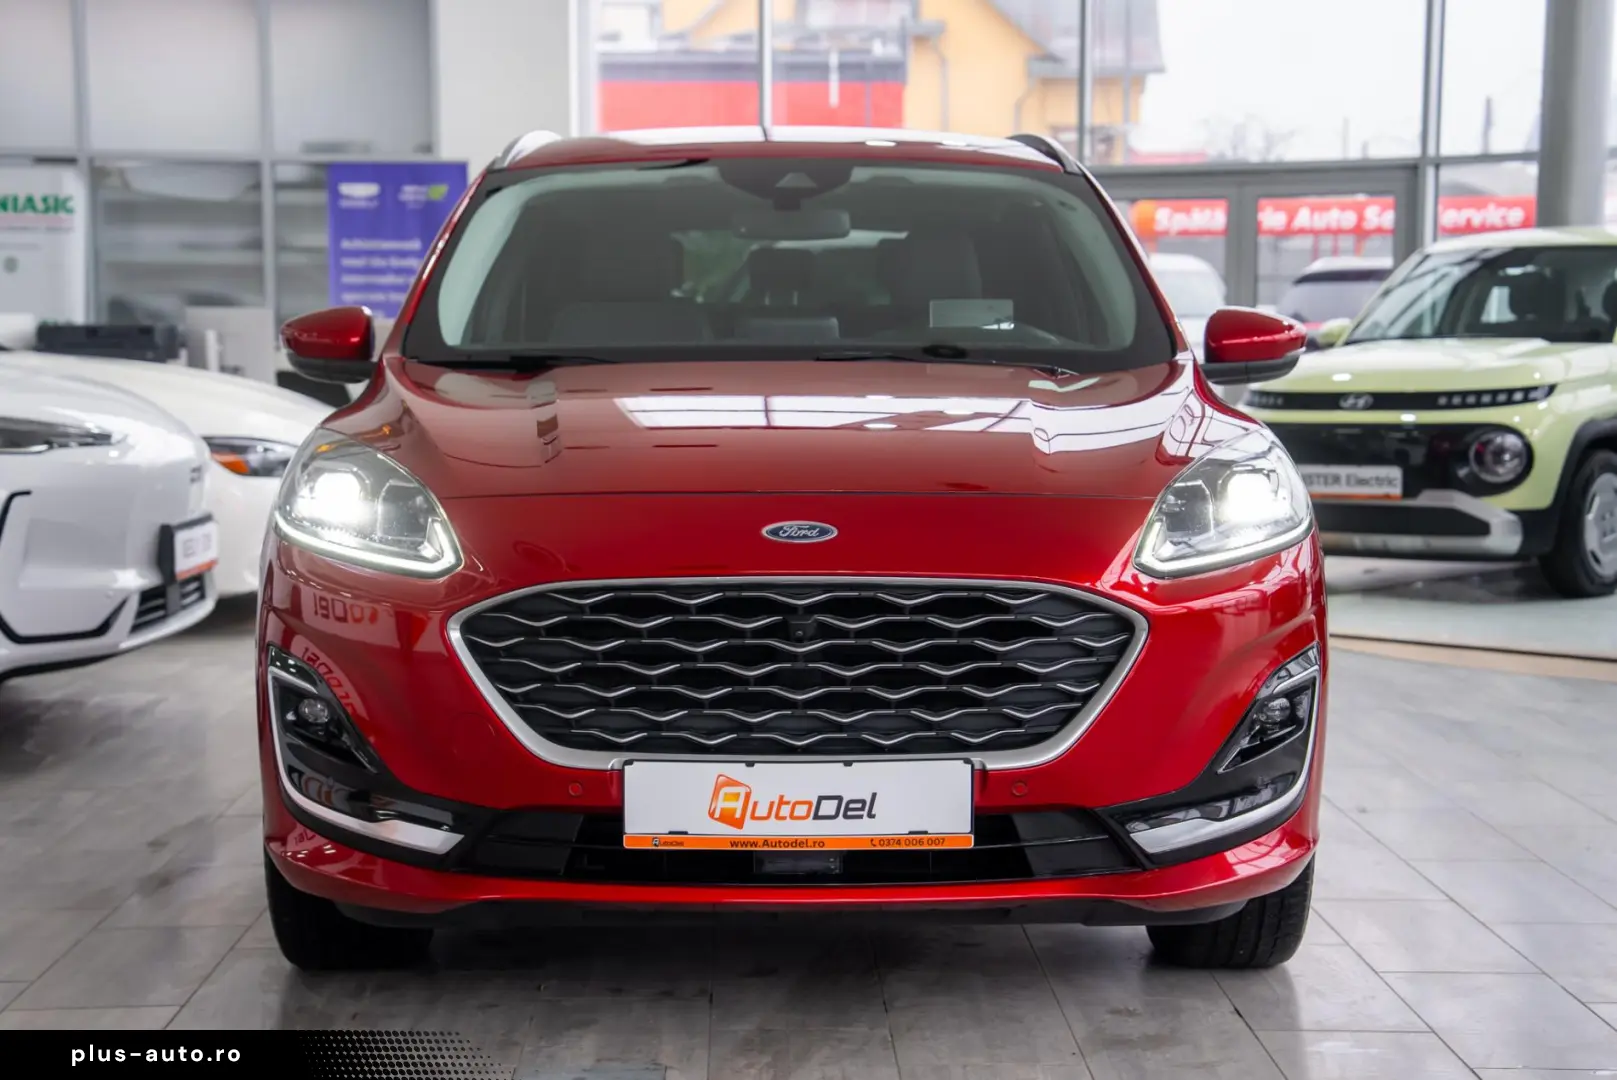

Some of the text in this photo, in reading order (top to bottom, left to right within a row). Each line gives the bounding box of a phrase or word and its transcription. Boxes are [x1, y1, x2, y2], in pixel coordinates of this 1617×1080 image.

[1291, 205, 1358, 231] Auto
[1345, 473, 1399, 488] Electric
[779, 525, 820, 537] Ford
[713, 783, 877, 822] AutoDel
[730, 839, 825, 849] www.Autodel.ro
[878, 838, 901, 847] 0374
[904, 838, 924, 847] 006
[927, 838, 945, 847] 007
